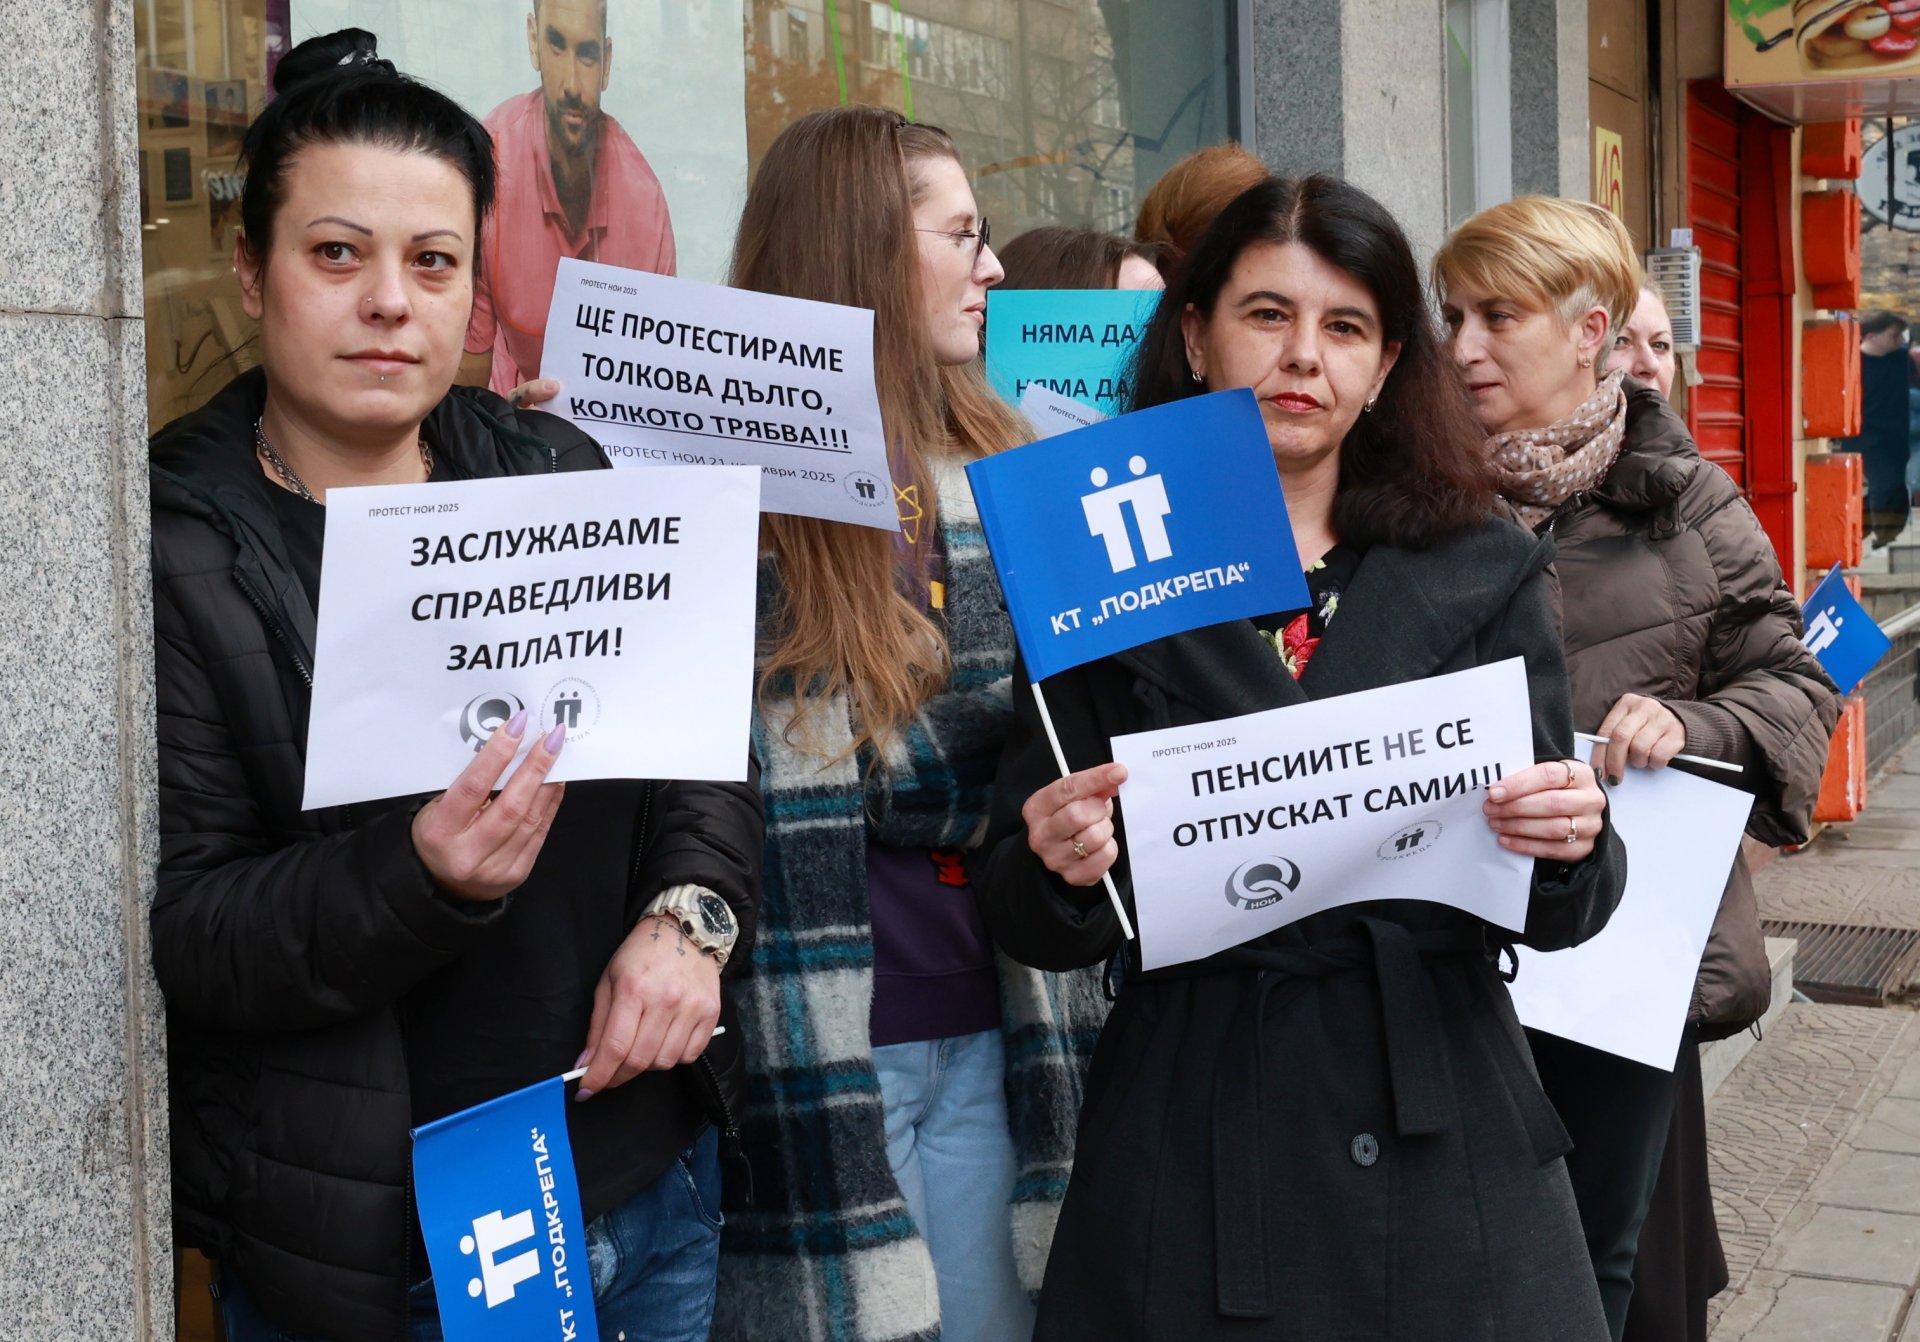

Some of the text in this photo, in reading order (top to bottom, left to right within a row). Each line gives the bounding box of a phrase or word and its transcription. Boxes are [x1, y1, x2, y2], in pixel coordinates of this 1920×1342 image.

[580, 278, 638, 296] ПРОТЕСТ НОИ 2025
[576, 303, 844, 373] ЩЕ ПРОТЕСТИРАМЕ
[1022, 324, 1137, 348] НЯМА ДА
[582, 352, 833, 416] ТОЛКОВА ДЪЛГО,
[1095, 378, 1130, 402] ДА
[570, 397, 851, 450] КОЛКОТО ТРЯБВА!!!
[1048, 404, 1076, 421] ПРОТЕСТ
[601, 443, 668, 461] ПРОТЕСТ
[672, 451, 705, 466] НОИ
[800, 469, 836, 483] 2025
[368, 503, 460, 518] ПРОТЕСТ НОИ 2025
[410, 516, 681, 567] ЗАСЛУЖАВАМЕ
[411, 572, 671, 622] СПРАВЕДЛИВИ
[1050, 561, 1250, 635] КТ „ПОДКРЕПА“
[446, 627, 623, 671] ЗАПЛАТИ!
[1152, 736, 1238, 758] ПРОТЕСТ НОИ 2025
[1190, 718, 1474, 798] ПЕНСИИТЕ НЕ СЕ
[1172, 793, 1353, 848] ОТПУСКАТ
[1363, 762, 1502, 814] САМИ!!!
[1250, 896, 1277, 910] НОИ
[531, 1127, 577, 1342] КТ „ПОДКРЕПА“
